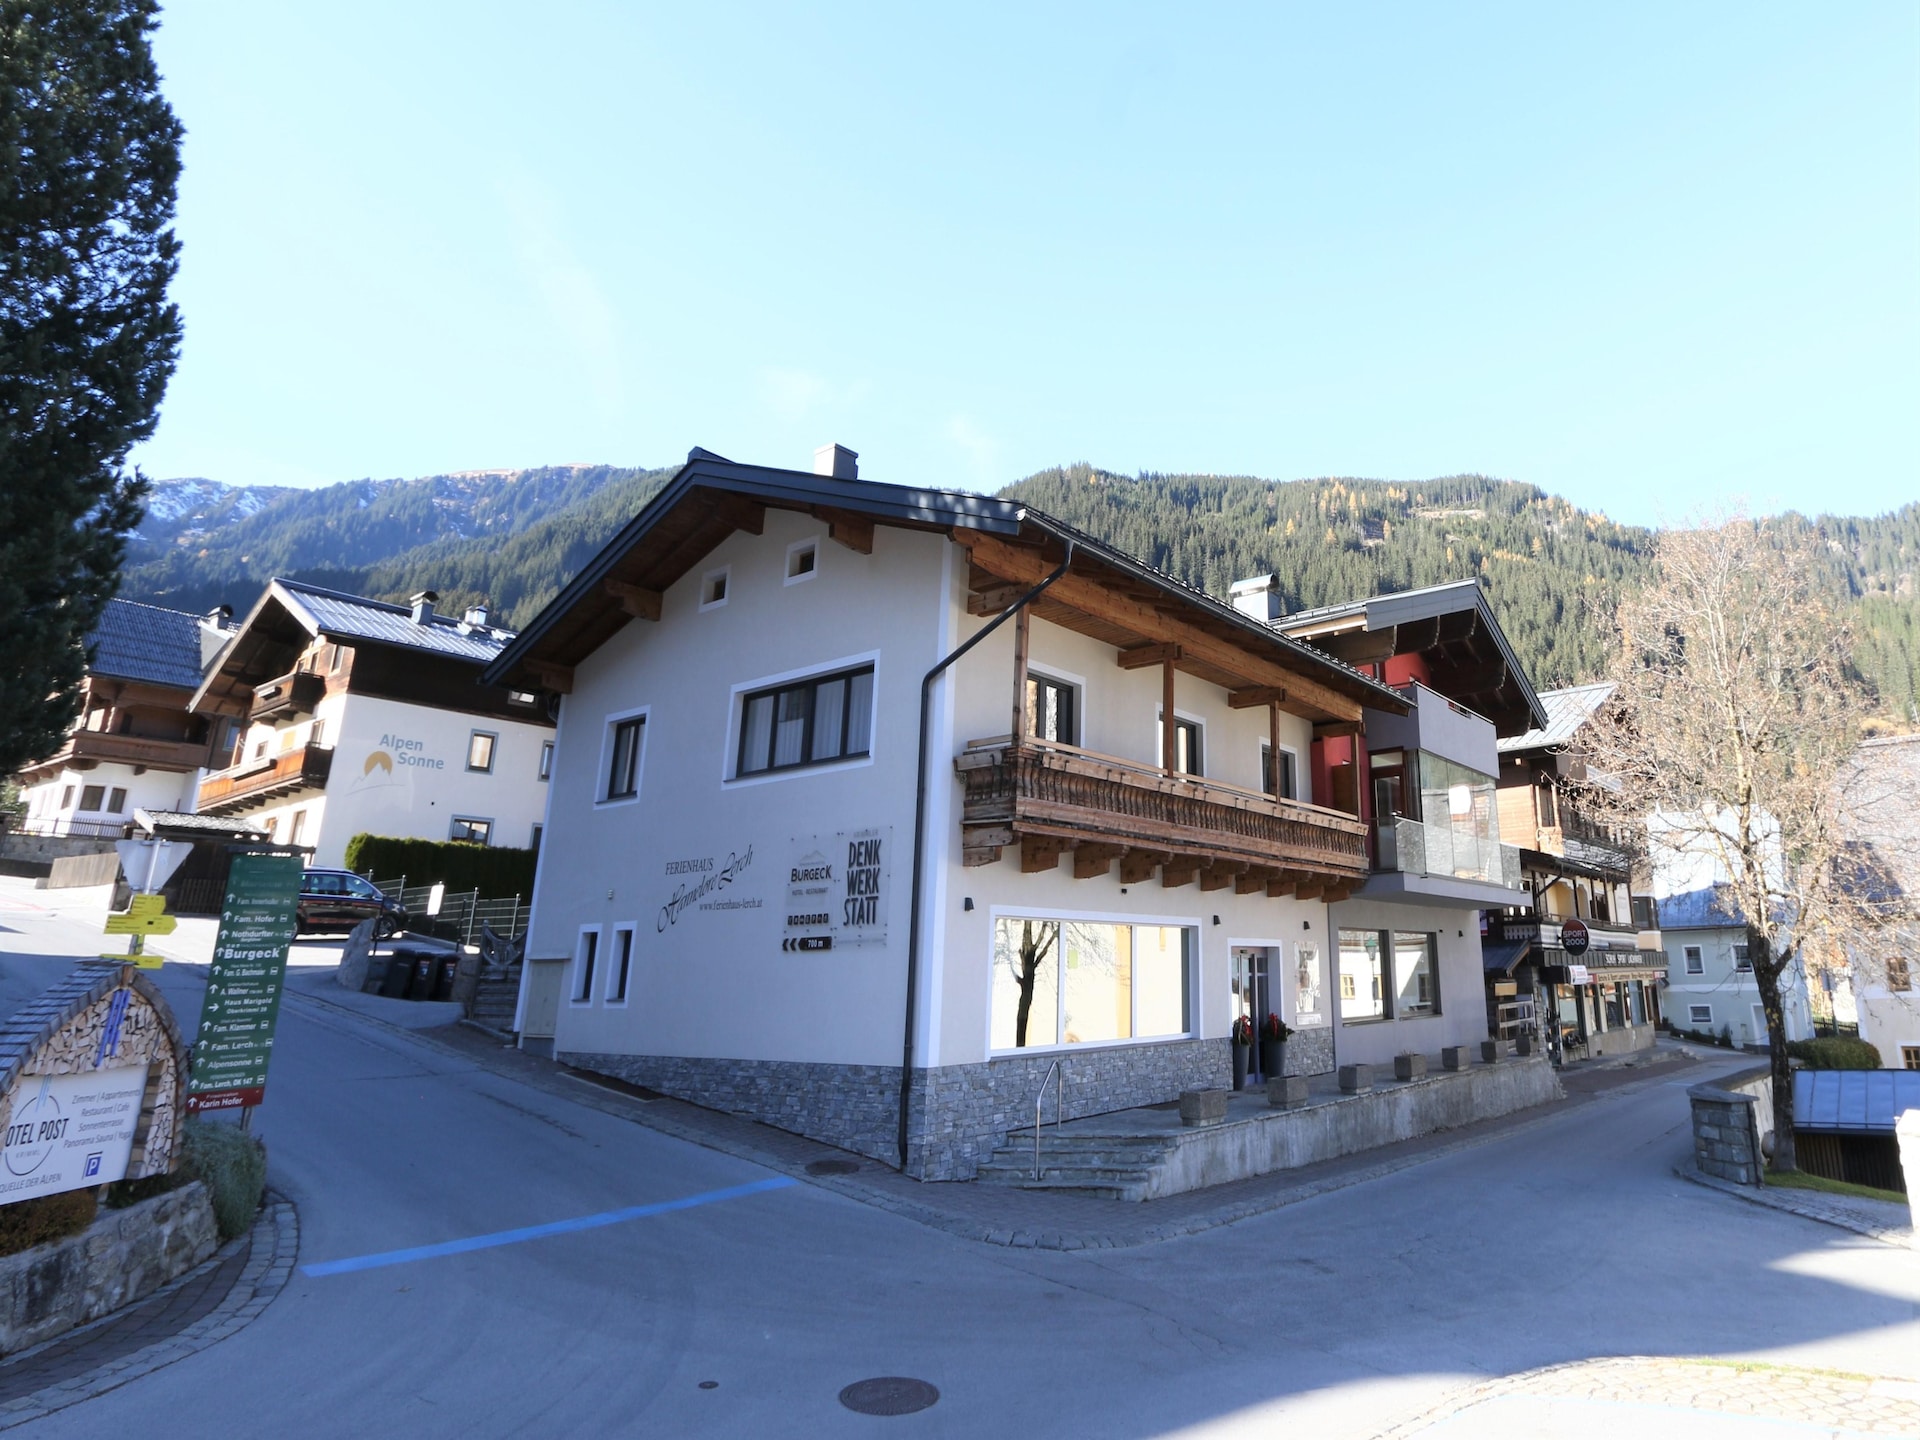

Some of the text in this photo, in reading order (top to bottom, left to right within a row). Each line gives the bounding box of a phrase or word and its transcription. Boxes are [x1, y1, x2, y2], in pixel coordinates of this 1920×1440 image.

[379, 734, 423, 751] Alpen
[397, 752, 444, 770] Sonne
[848, 839, 882, 868] DENK
[665, 858, 714, 875] FERIENHAUS
[718, 844, 753, 890] Lerch
[791, 864, 832, 882] BURGECK
[846, 867, 880, 897] WERK
[234, 914, 275, 923] Fam. Hofer
[843, 896, 879, 926] STATT
[1562, 930, 1587, 938] SPORT
[1566, 938, 1586, 946] 2000
[224, 948, 280, 960] Burgeck
[207, 1060, 252, 1069] Alpensonne
[198, 1097, 243, 1109] Karin Hofer
[37, 1118, 69, 1142] POST
